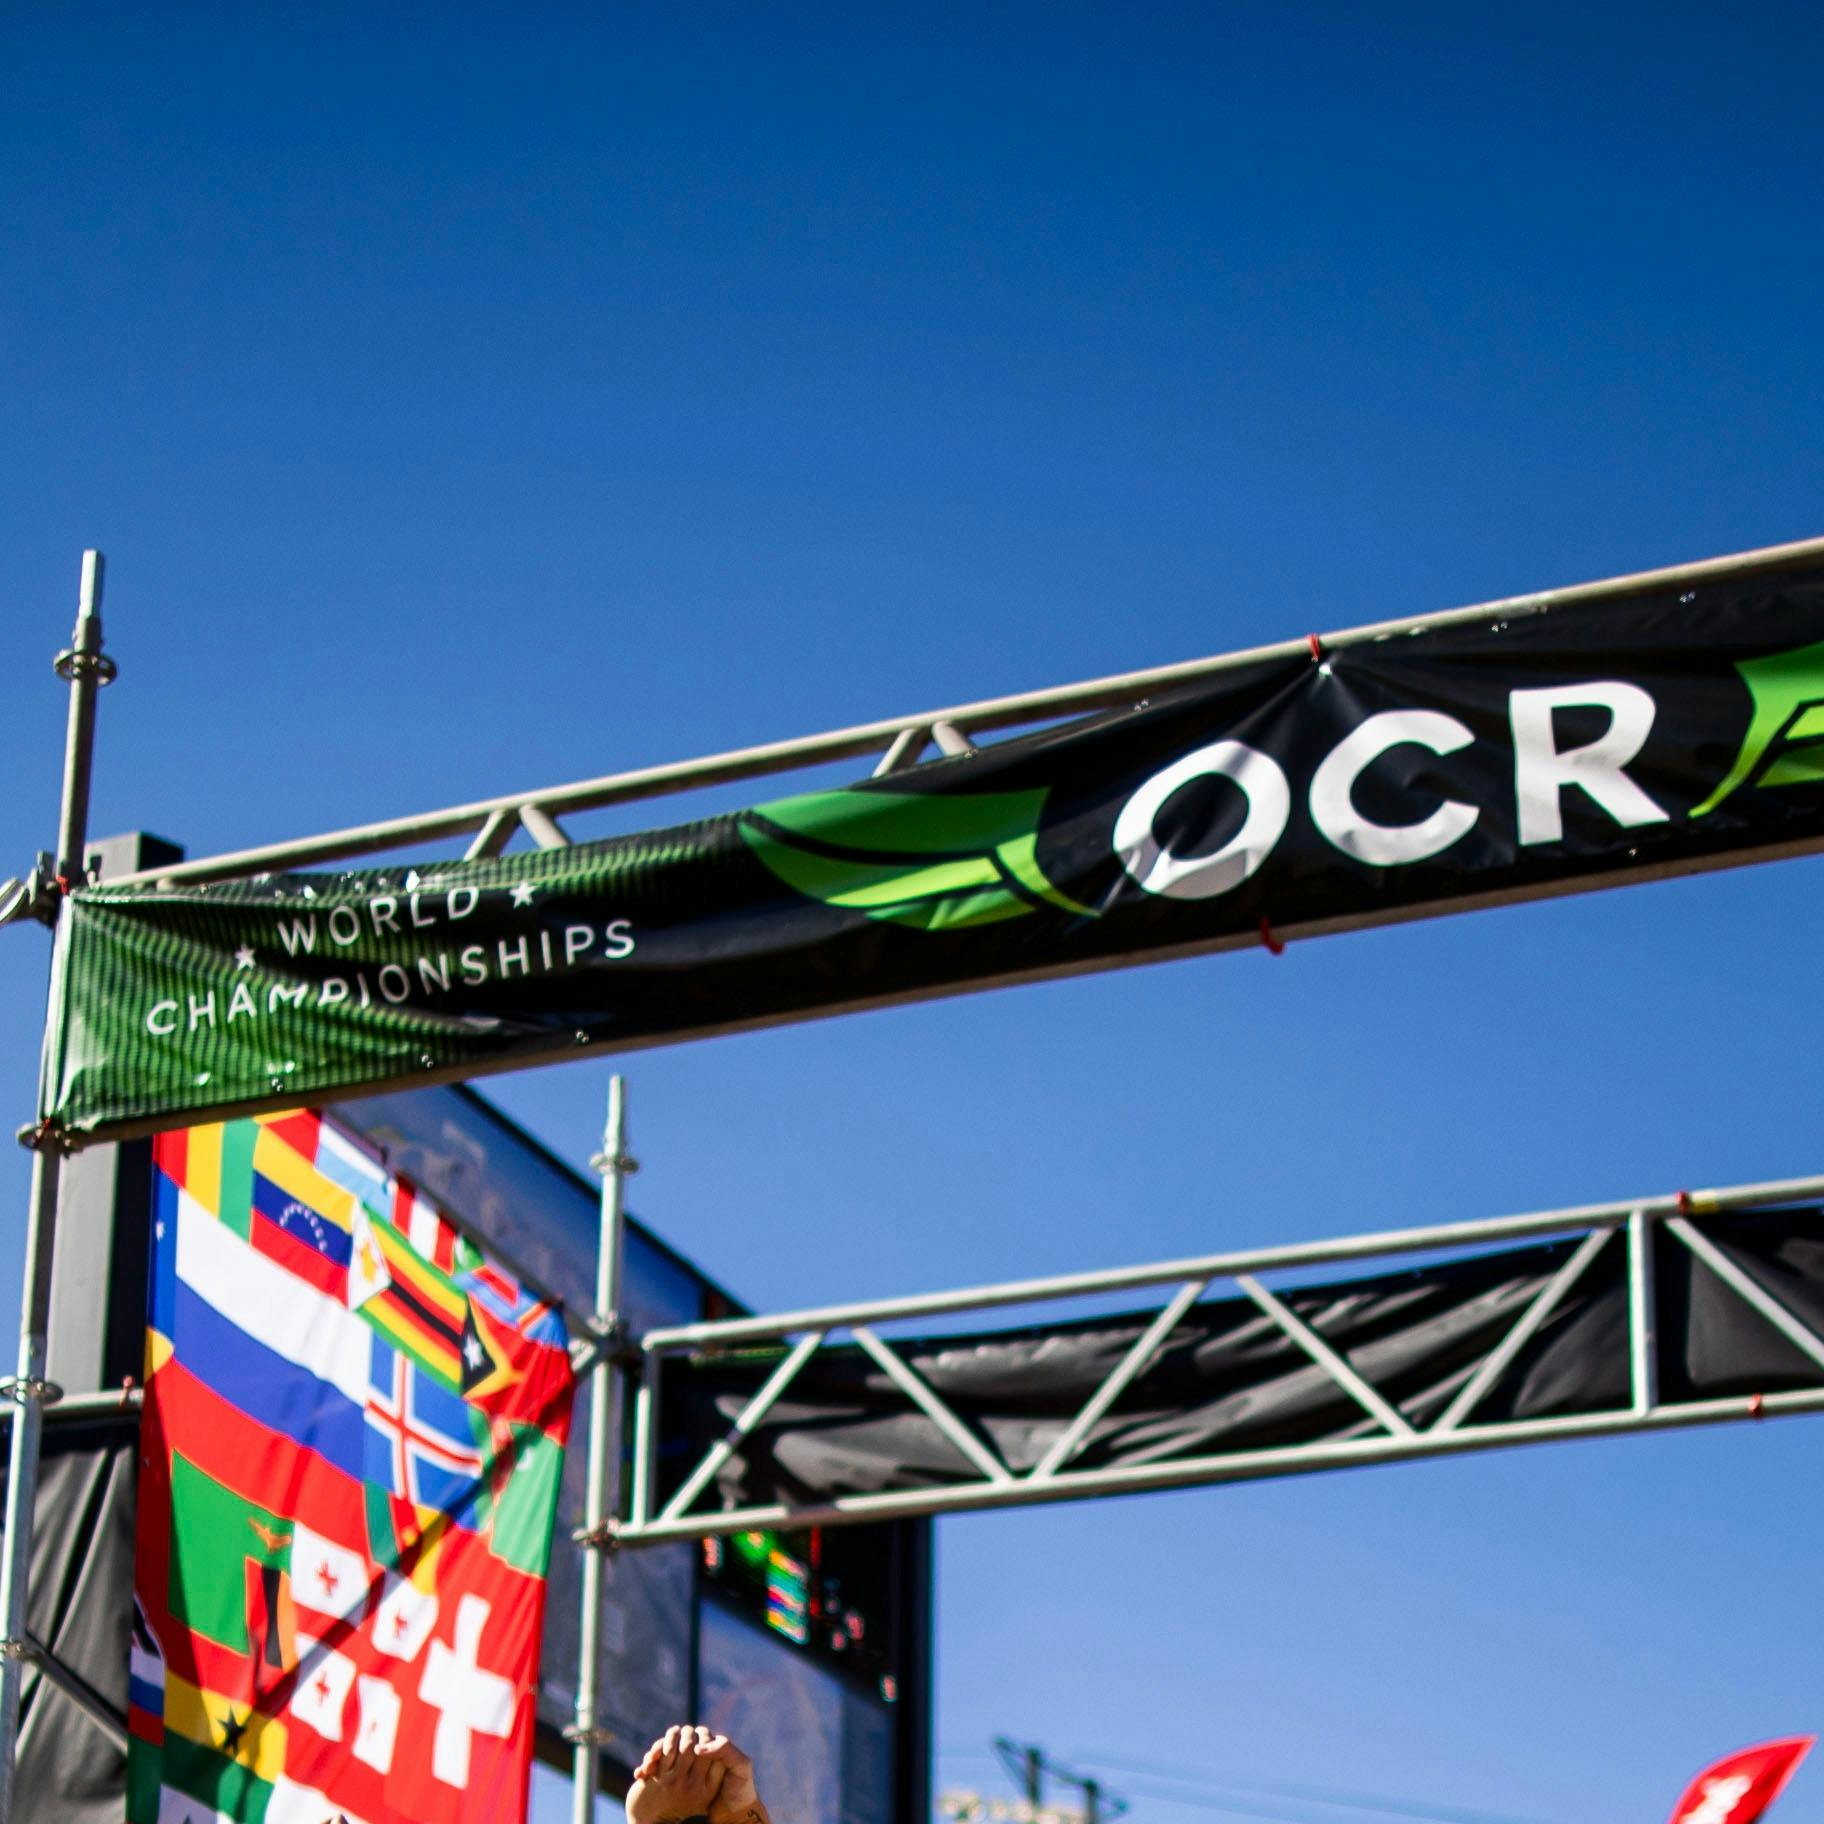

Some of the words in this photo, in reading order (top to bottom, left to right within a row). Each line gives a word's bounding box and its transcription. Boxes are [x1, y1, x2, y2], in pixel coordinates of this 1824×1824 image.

[1112, 681, 1670, 899] OCR
[146, 919, 636, 1036] CHAMPIONSHIPS
[277, 886, 479, 957] WORLD
